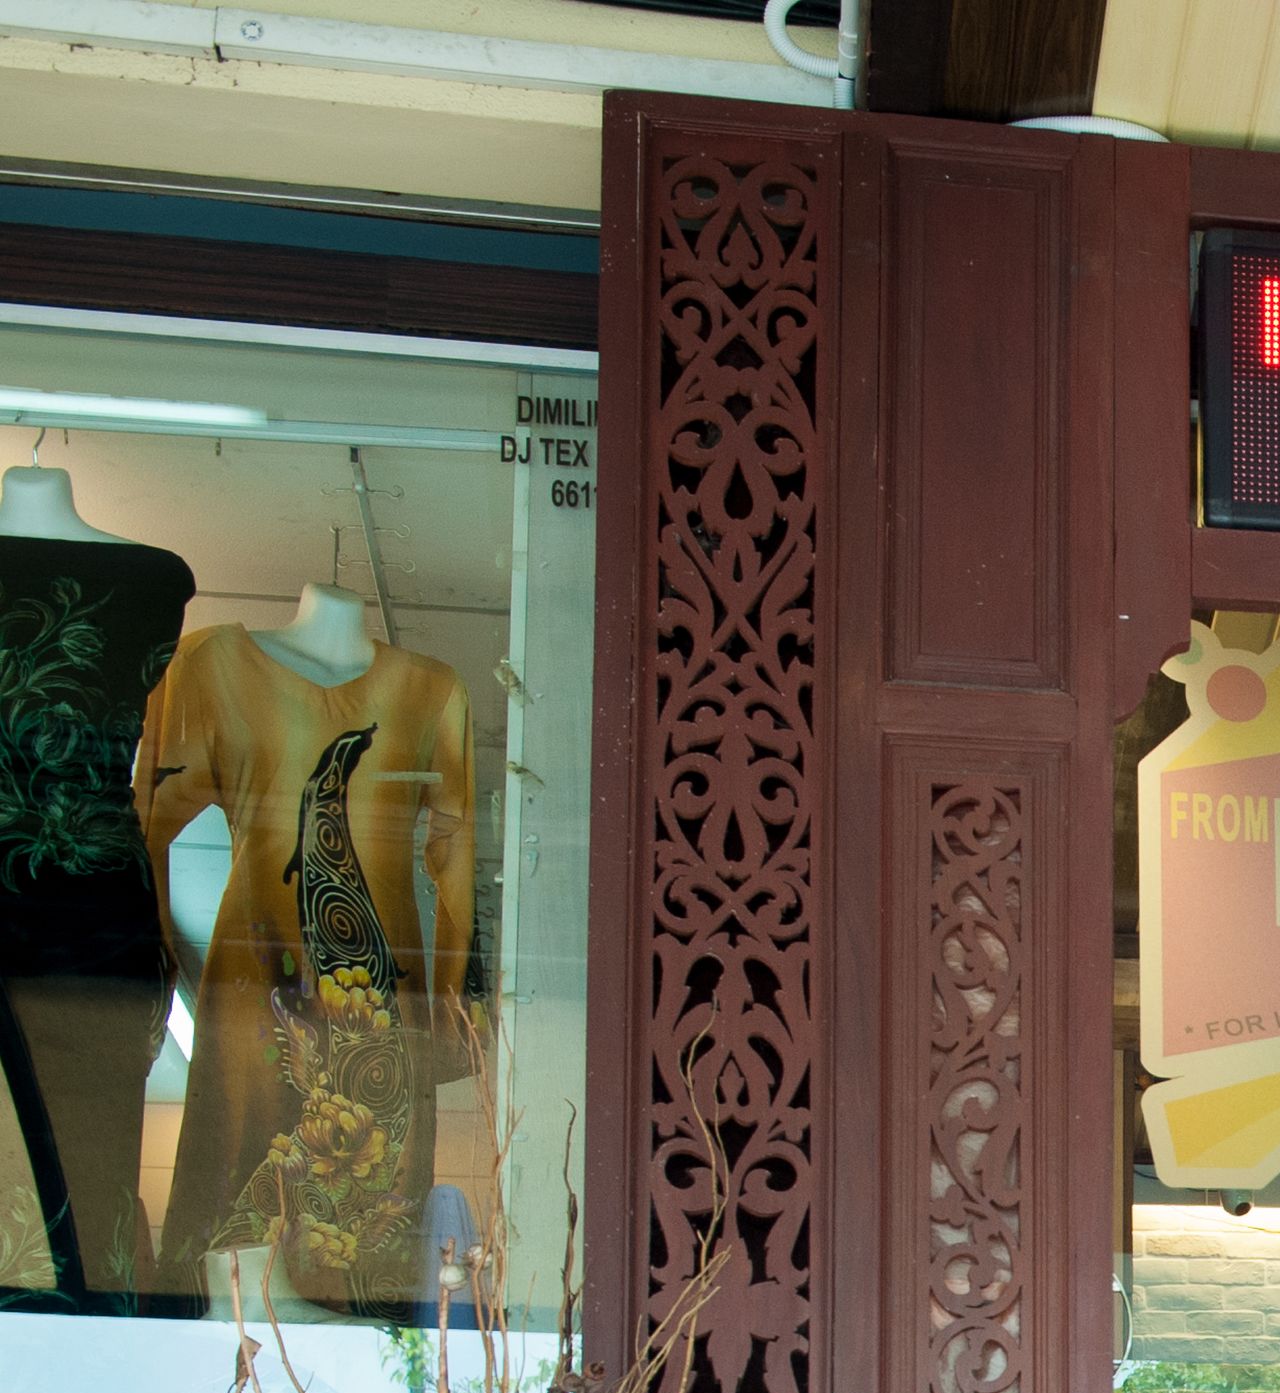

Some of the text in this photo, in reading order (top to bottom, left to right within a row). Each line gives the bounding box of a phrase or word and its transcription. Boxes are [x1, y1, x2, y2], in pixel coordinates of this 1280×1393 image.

[500, 435, 589, 468] DJ TEX
[551, 479, 598, 508] 661
[1169, 791, 1269, 844] FROM
[1205, 1013, 1265, 1041] FOR
